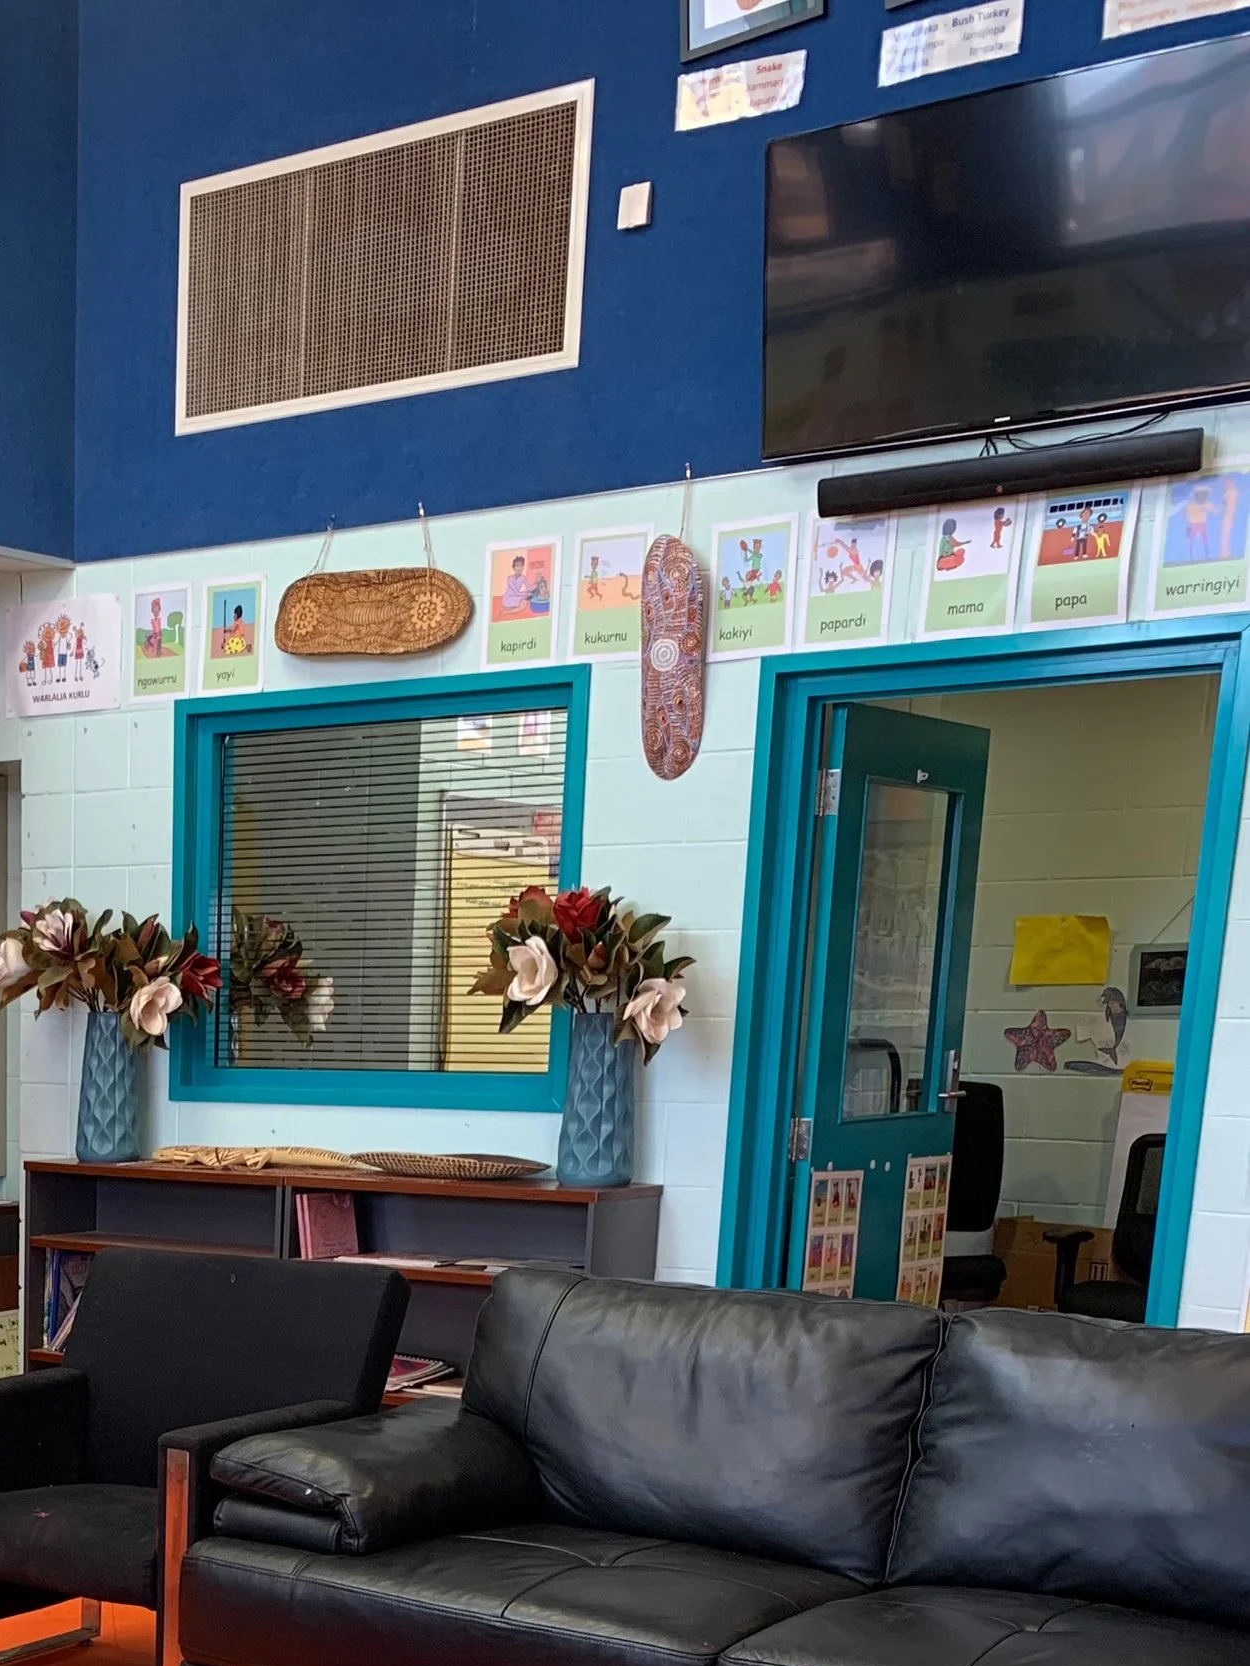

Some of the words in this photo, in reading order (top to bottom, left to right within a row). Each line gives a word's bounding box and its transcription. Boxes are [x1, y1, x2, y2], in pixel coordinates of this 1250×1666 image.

[952, 15, 975, 28] Bush
[978, 7, 1010, 20] Turkey
[756, 62, 783, 74] Snake
[1165, 576, 1241, 598] warringiyi
[947, 600, 984, 615] mama
[1054, 592, 1088, 611] papa
[820, 613, 867, 634] papardi
[584, 630, 627, 645] kukurnu
[719, 625, 753, 642] kakiyi
[500, 639, 537, 655] kapirdi
[138, 675, 177, 691] ngawurru
[216, 668, 235, 683] yayi
[69, 689, 90, 700] KURLU
